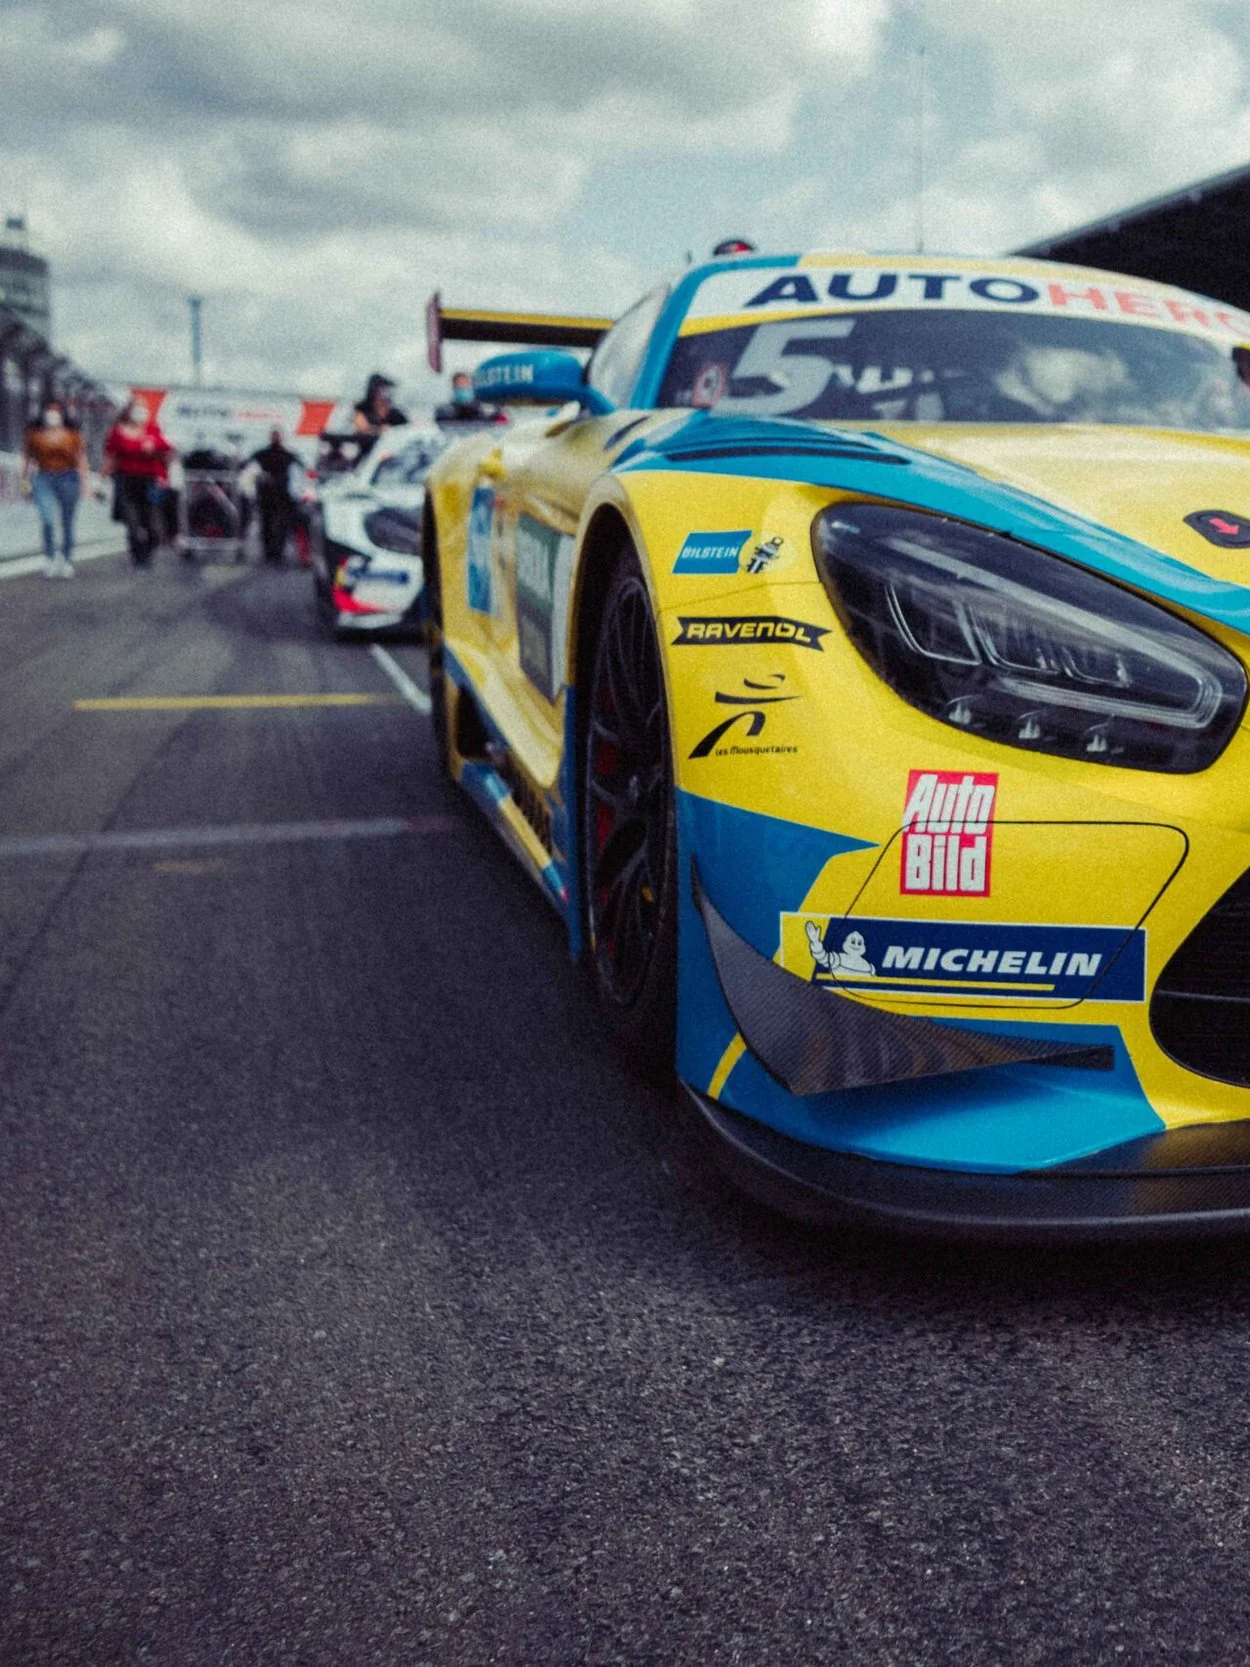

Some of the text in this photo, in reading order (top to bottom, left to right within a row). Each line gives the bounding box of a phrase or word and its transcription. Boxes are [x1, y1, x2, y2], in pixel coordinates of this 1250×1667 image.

[708, 318, 857, 418] 5
[681, 546, 739, 559] BILSTEIN
[686, 622, 812, 643] RAVENOL
[903, 774, 996, 835] Auto
[906, 834, 988, 892] Bild
[882, 945, 1102, 977] MICHELIN
